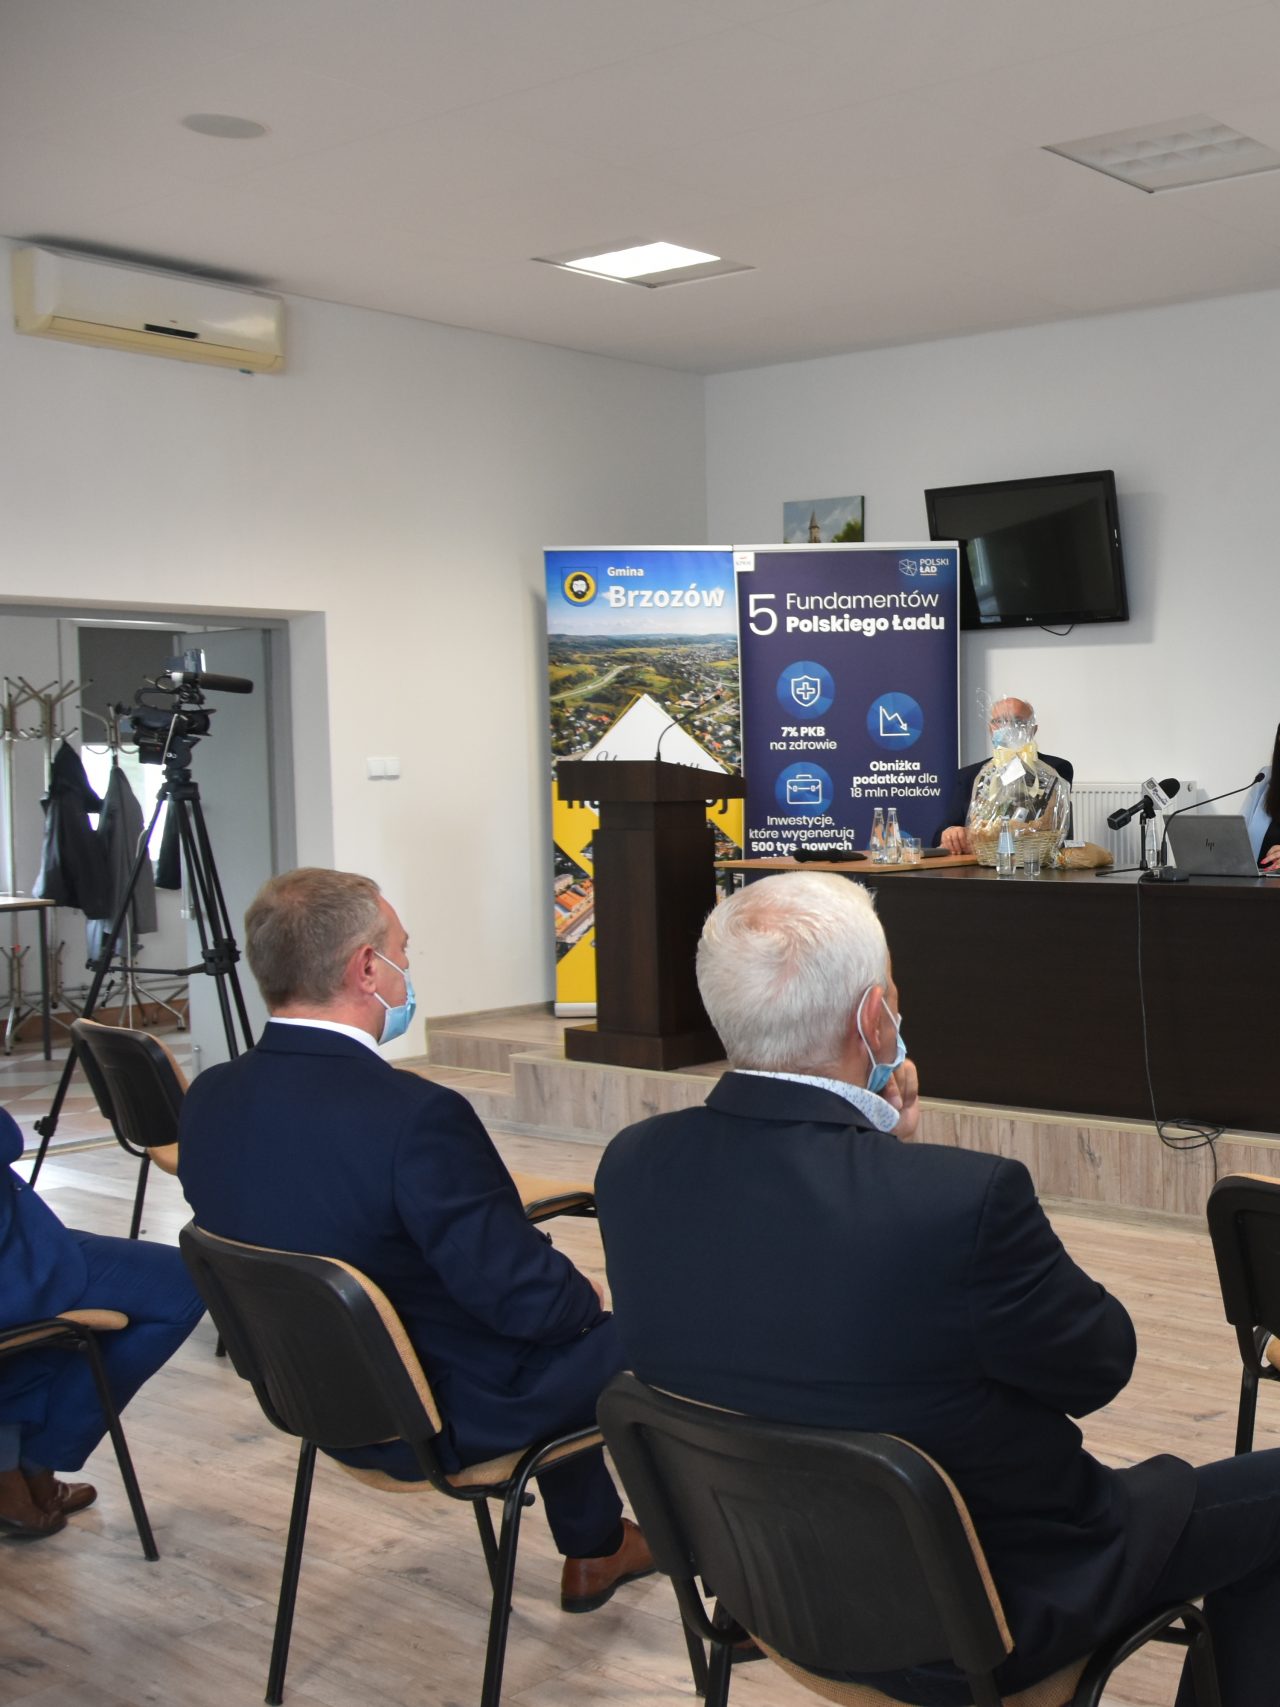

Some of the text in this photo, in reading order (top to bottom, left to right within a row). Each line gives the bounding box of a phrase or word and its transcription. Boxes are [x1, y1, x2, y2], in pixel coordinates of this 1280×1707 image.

[920, 558, 949, 566] POLSKI
[607, 566, 644, 577] Gmina
[609, 582, 725, 608] Brzozów
[786, 590, 939, 610] Fundamentów
[749, 593, 778, 636] 5
[786, 611, 945, 637] Polskiego Ładu
[781, 726, 826, 737] 7% PKB
[770, 739, 837, 750] na zdrowie
[869, 760, 920, 771] Obniżka
[853, 773, 938, 787] podatków dla
[850, 787, 941, 798] 18 mln Polaków
[767, 814, 835, 828] Inwestycje,
[749, 828, 854, 842] które wygenerują
[752, 841, 774, 852] 500
